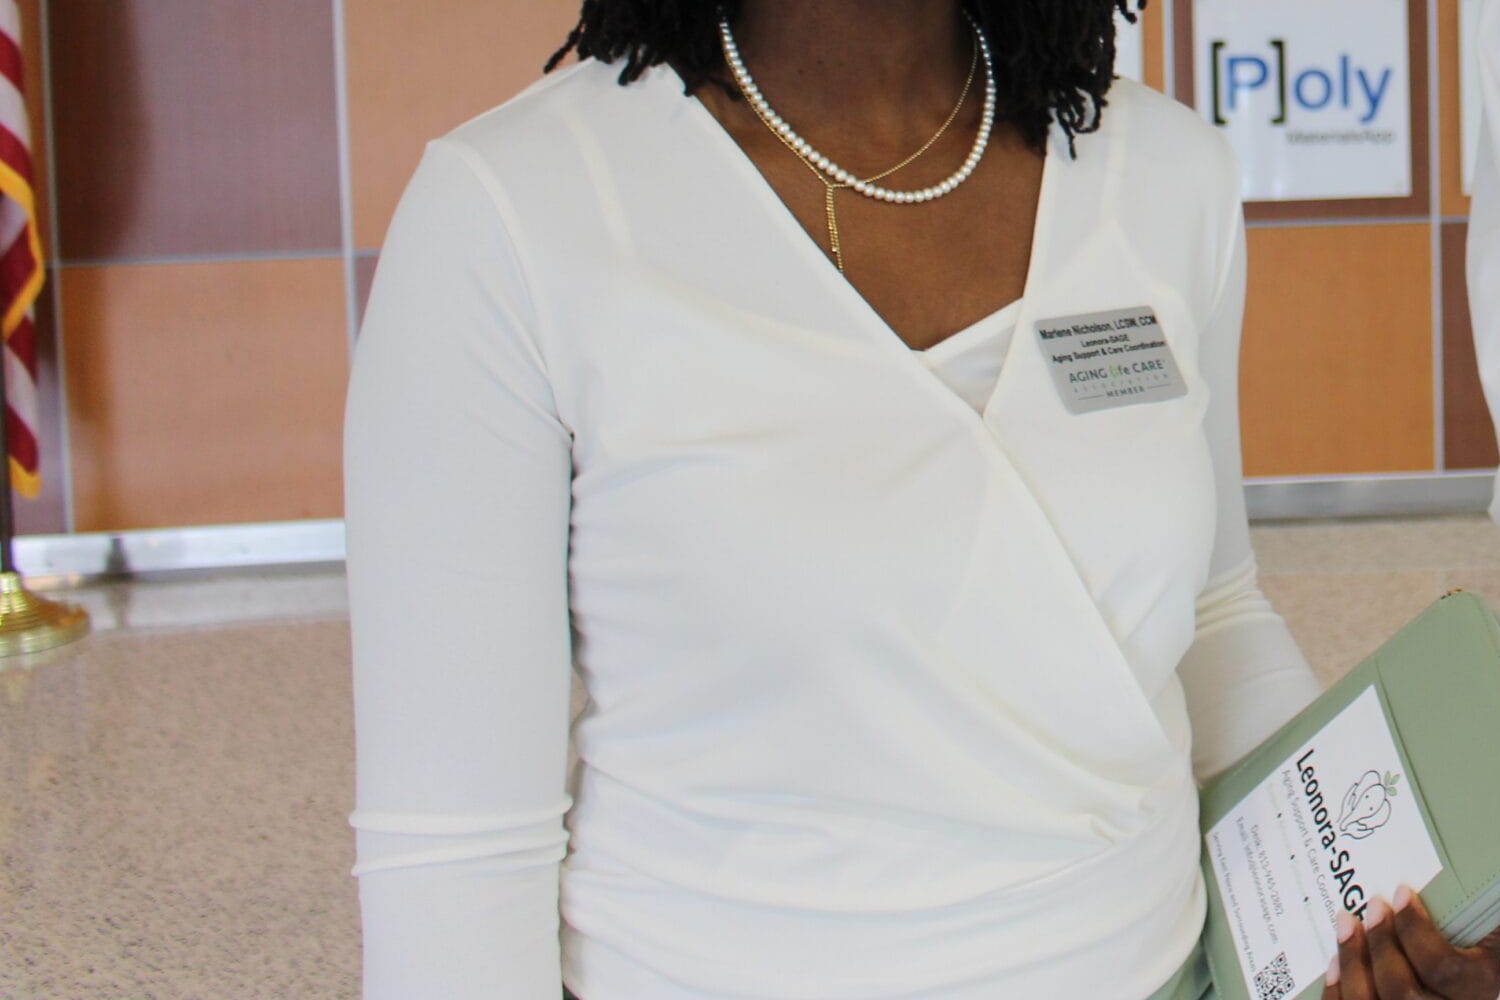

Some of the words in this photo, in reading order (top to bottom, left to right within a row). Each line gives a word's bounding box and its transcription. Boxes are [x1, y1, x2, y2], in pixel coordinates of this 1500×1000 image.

[1039, 328, 1073, 340] Marlene
[1052, 353, 1073, 364] Aging
[1073, 349, 1100, 361] Support
[1109, 346, 1124, 355] Care
[1068, 367, 1107, 384] AGING
[1132, 359, 1164, 374] CARE
[1106, 385, 1145, 398] MEMBER
[1307, 847, 1321, 874] Care
